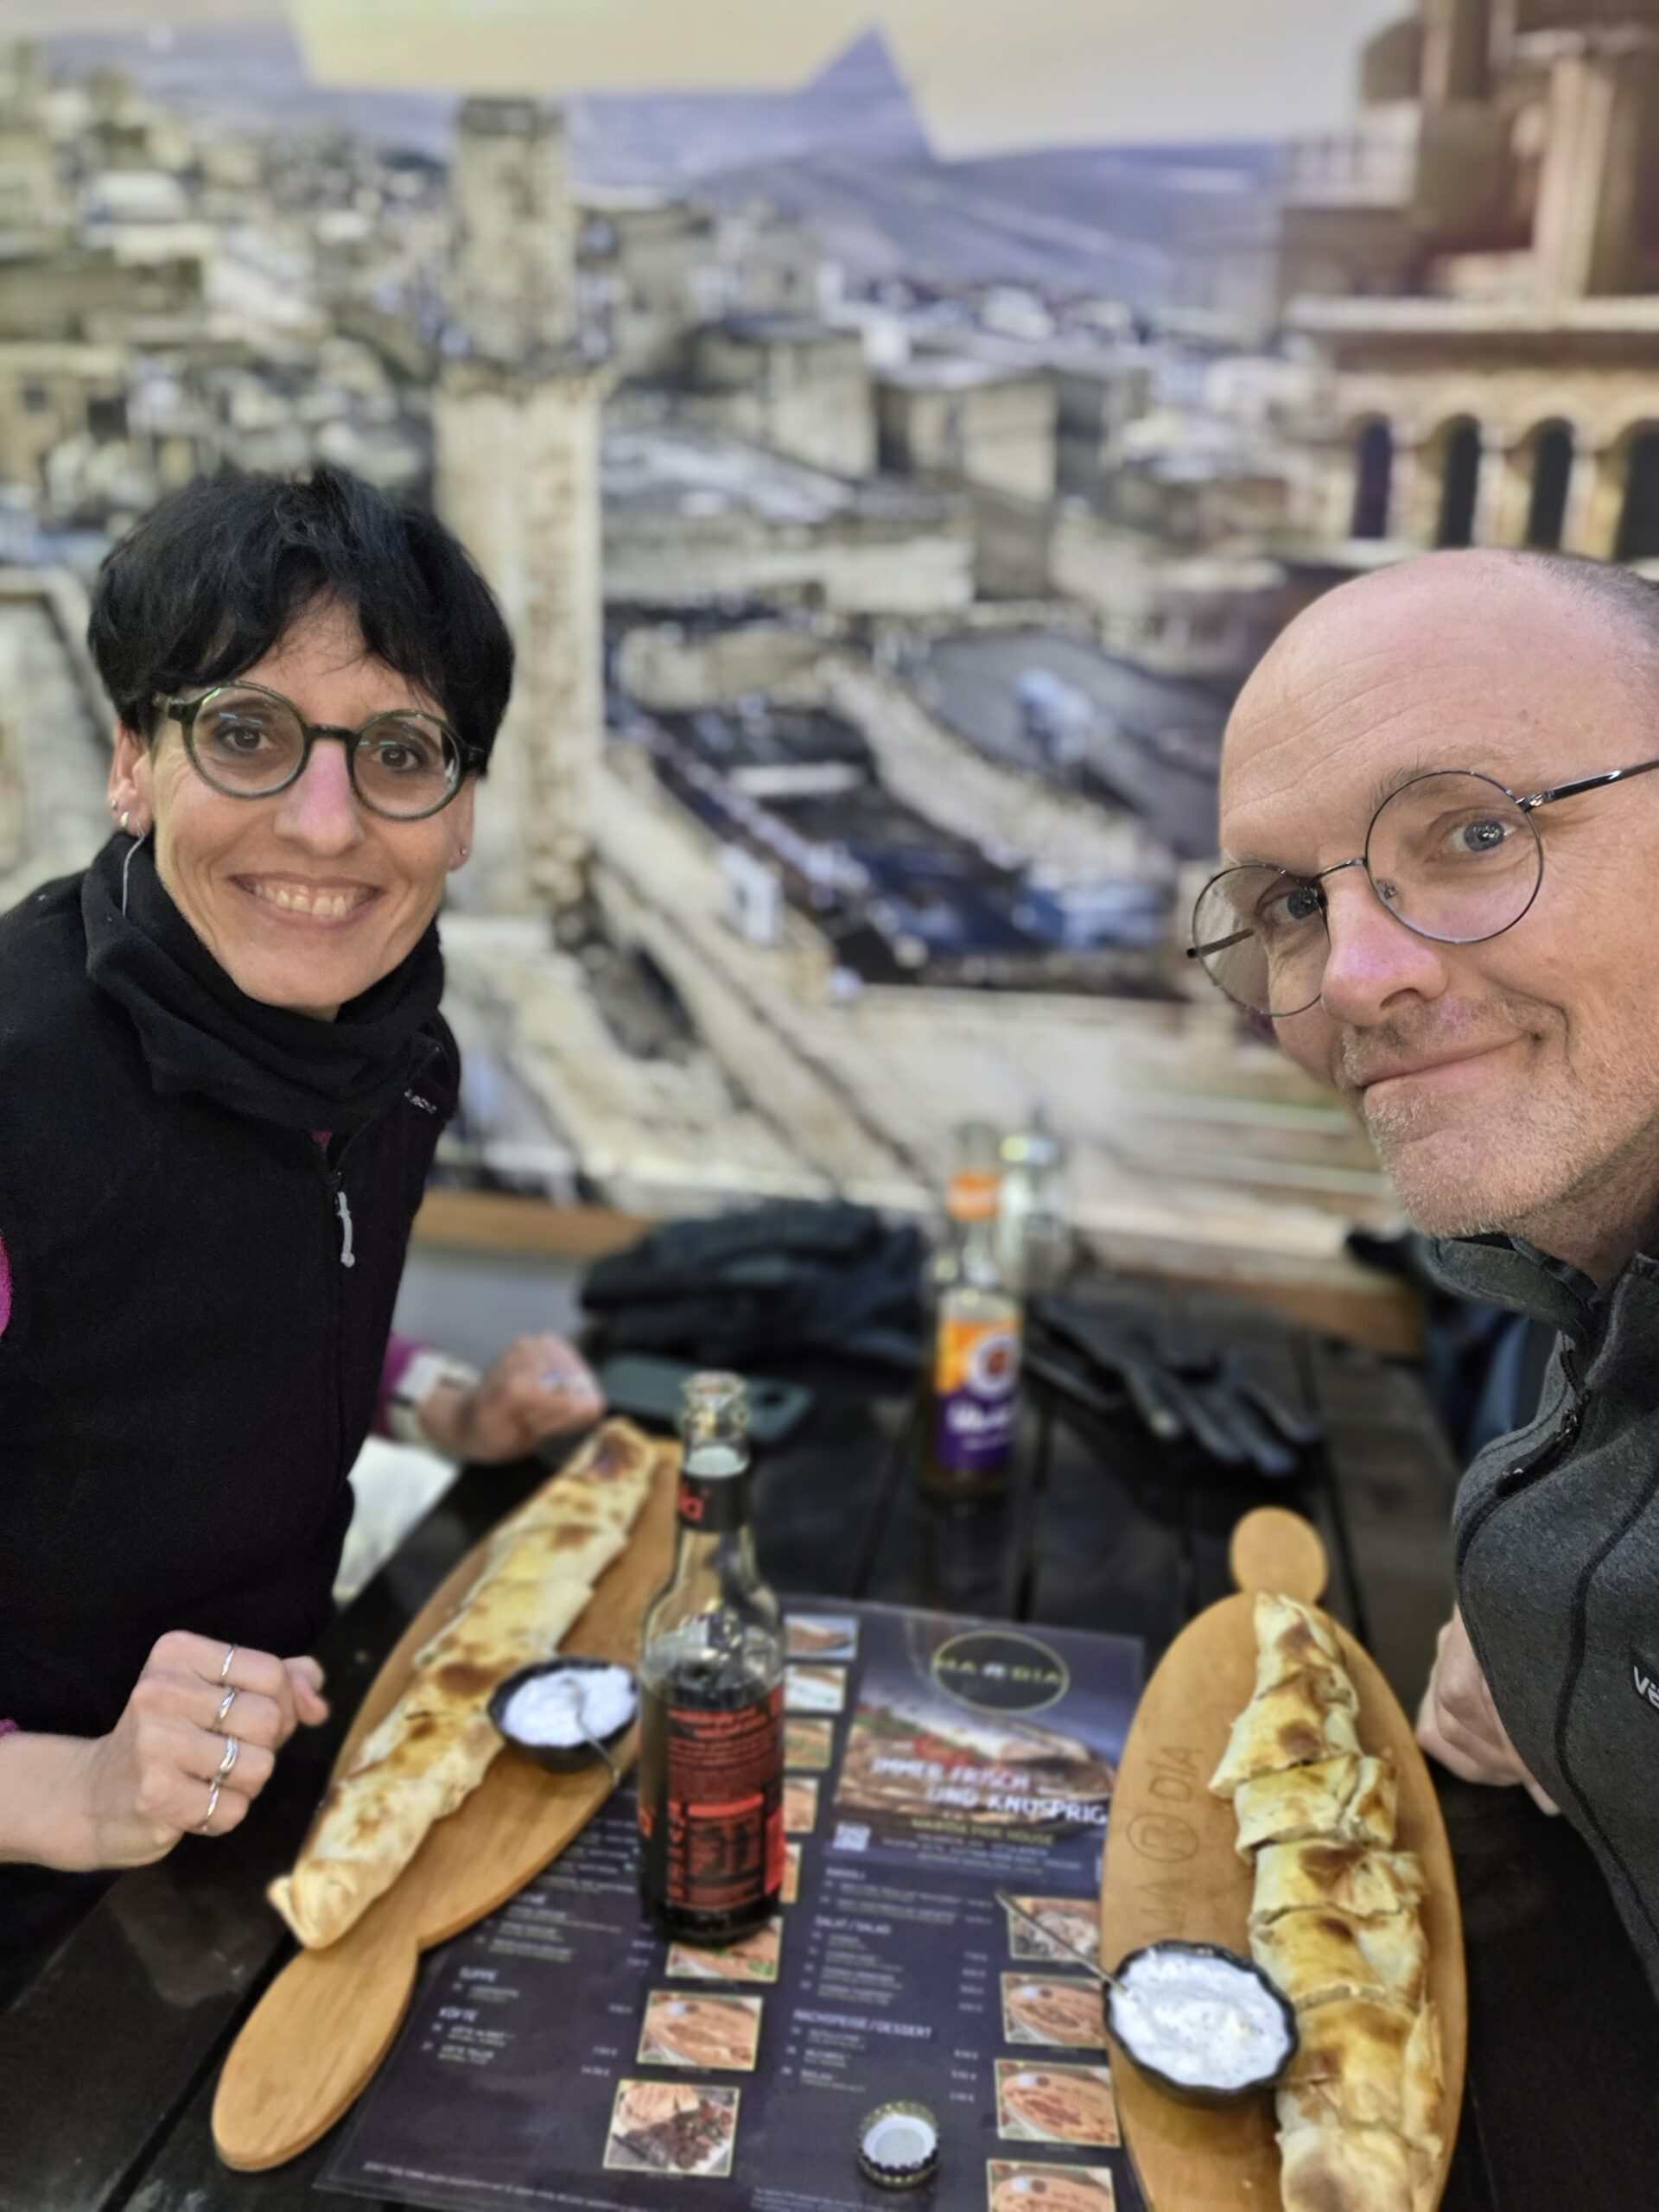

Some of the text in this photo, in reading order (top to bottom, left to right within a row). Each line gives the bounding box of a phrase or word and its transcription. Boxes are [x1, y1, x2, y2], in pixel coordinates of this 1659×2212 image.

[873, 1756, 1032, 1790] IMMER FRISCH
[927, 1783, 1109, 1825] UND KNUSPRIG
